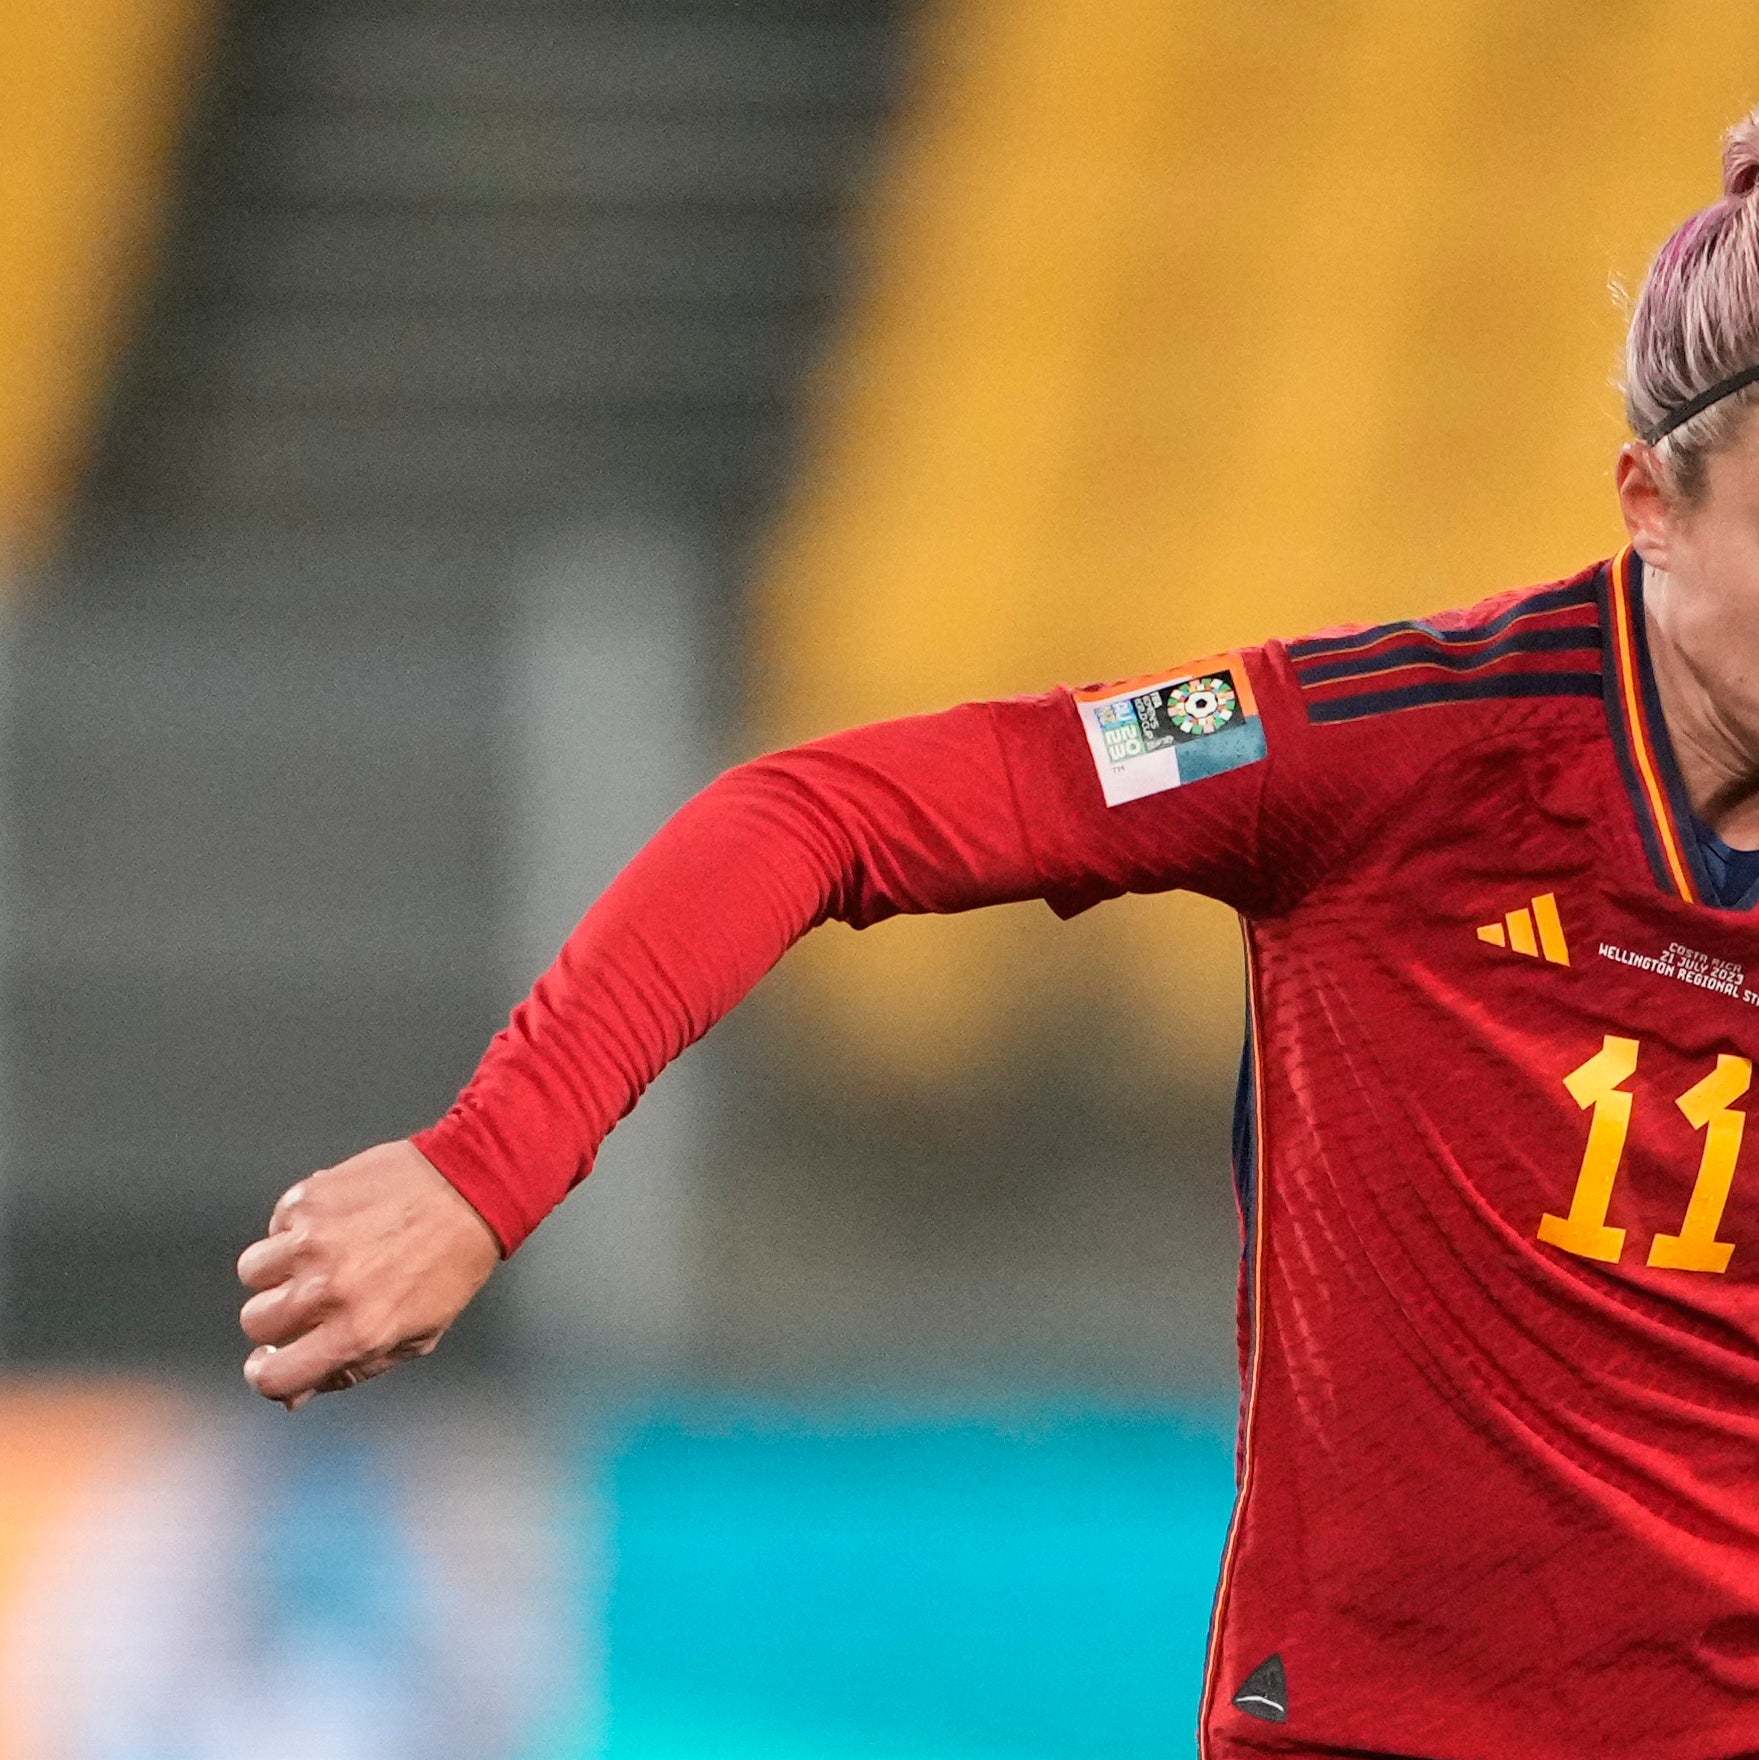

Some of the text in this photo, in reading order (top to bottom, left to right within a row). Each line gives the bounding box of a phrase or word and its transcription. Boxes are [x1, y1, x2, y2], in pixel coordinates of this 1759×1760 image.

[1598, 942, 1675, 977] WELLINGTON
[1677, 968, 1740, 999] REGIONAL
[1660, 950, 1745, 986] 21 JULY 2023
[1669, 942, 1708, 962] COSTA
[1536, 1034, 1752, 1274] 11
